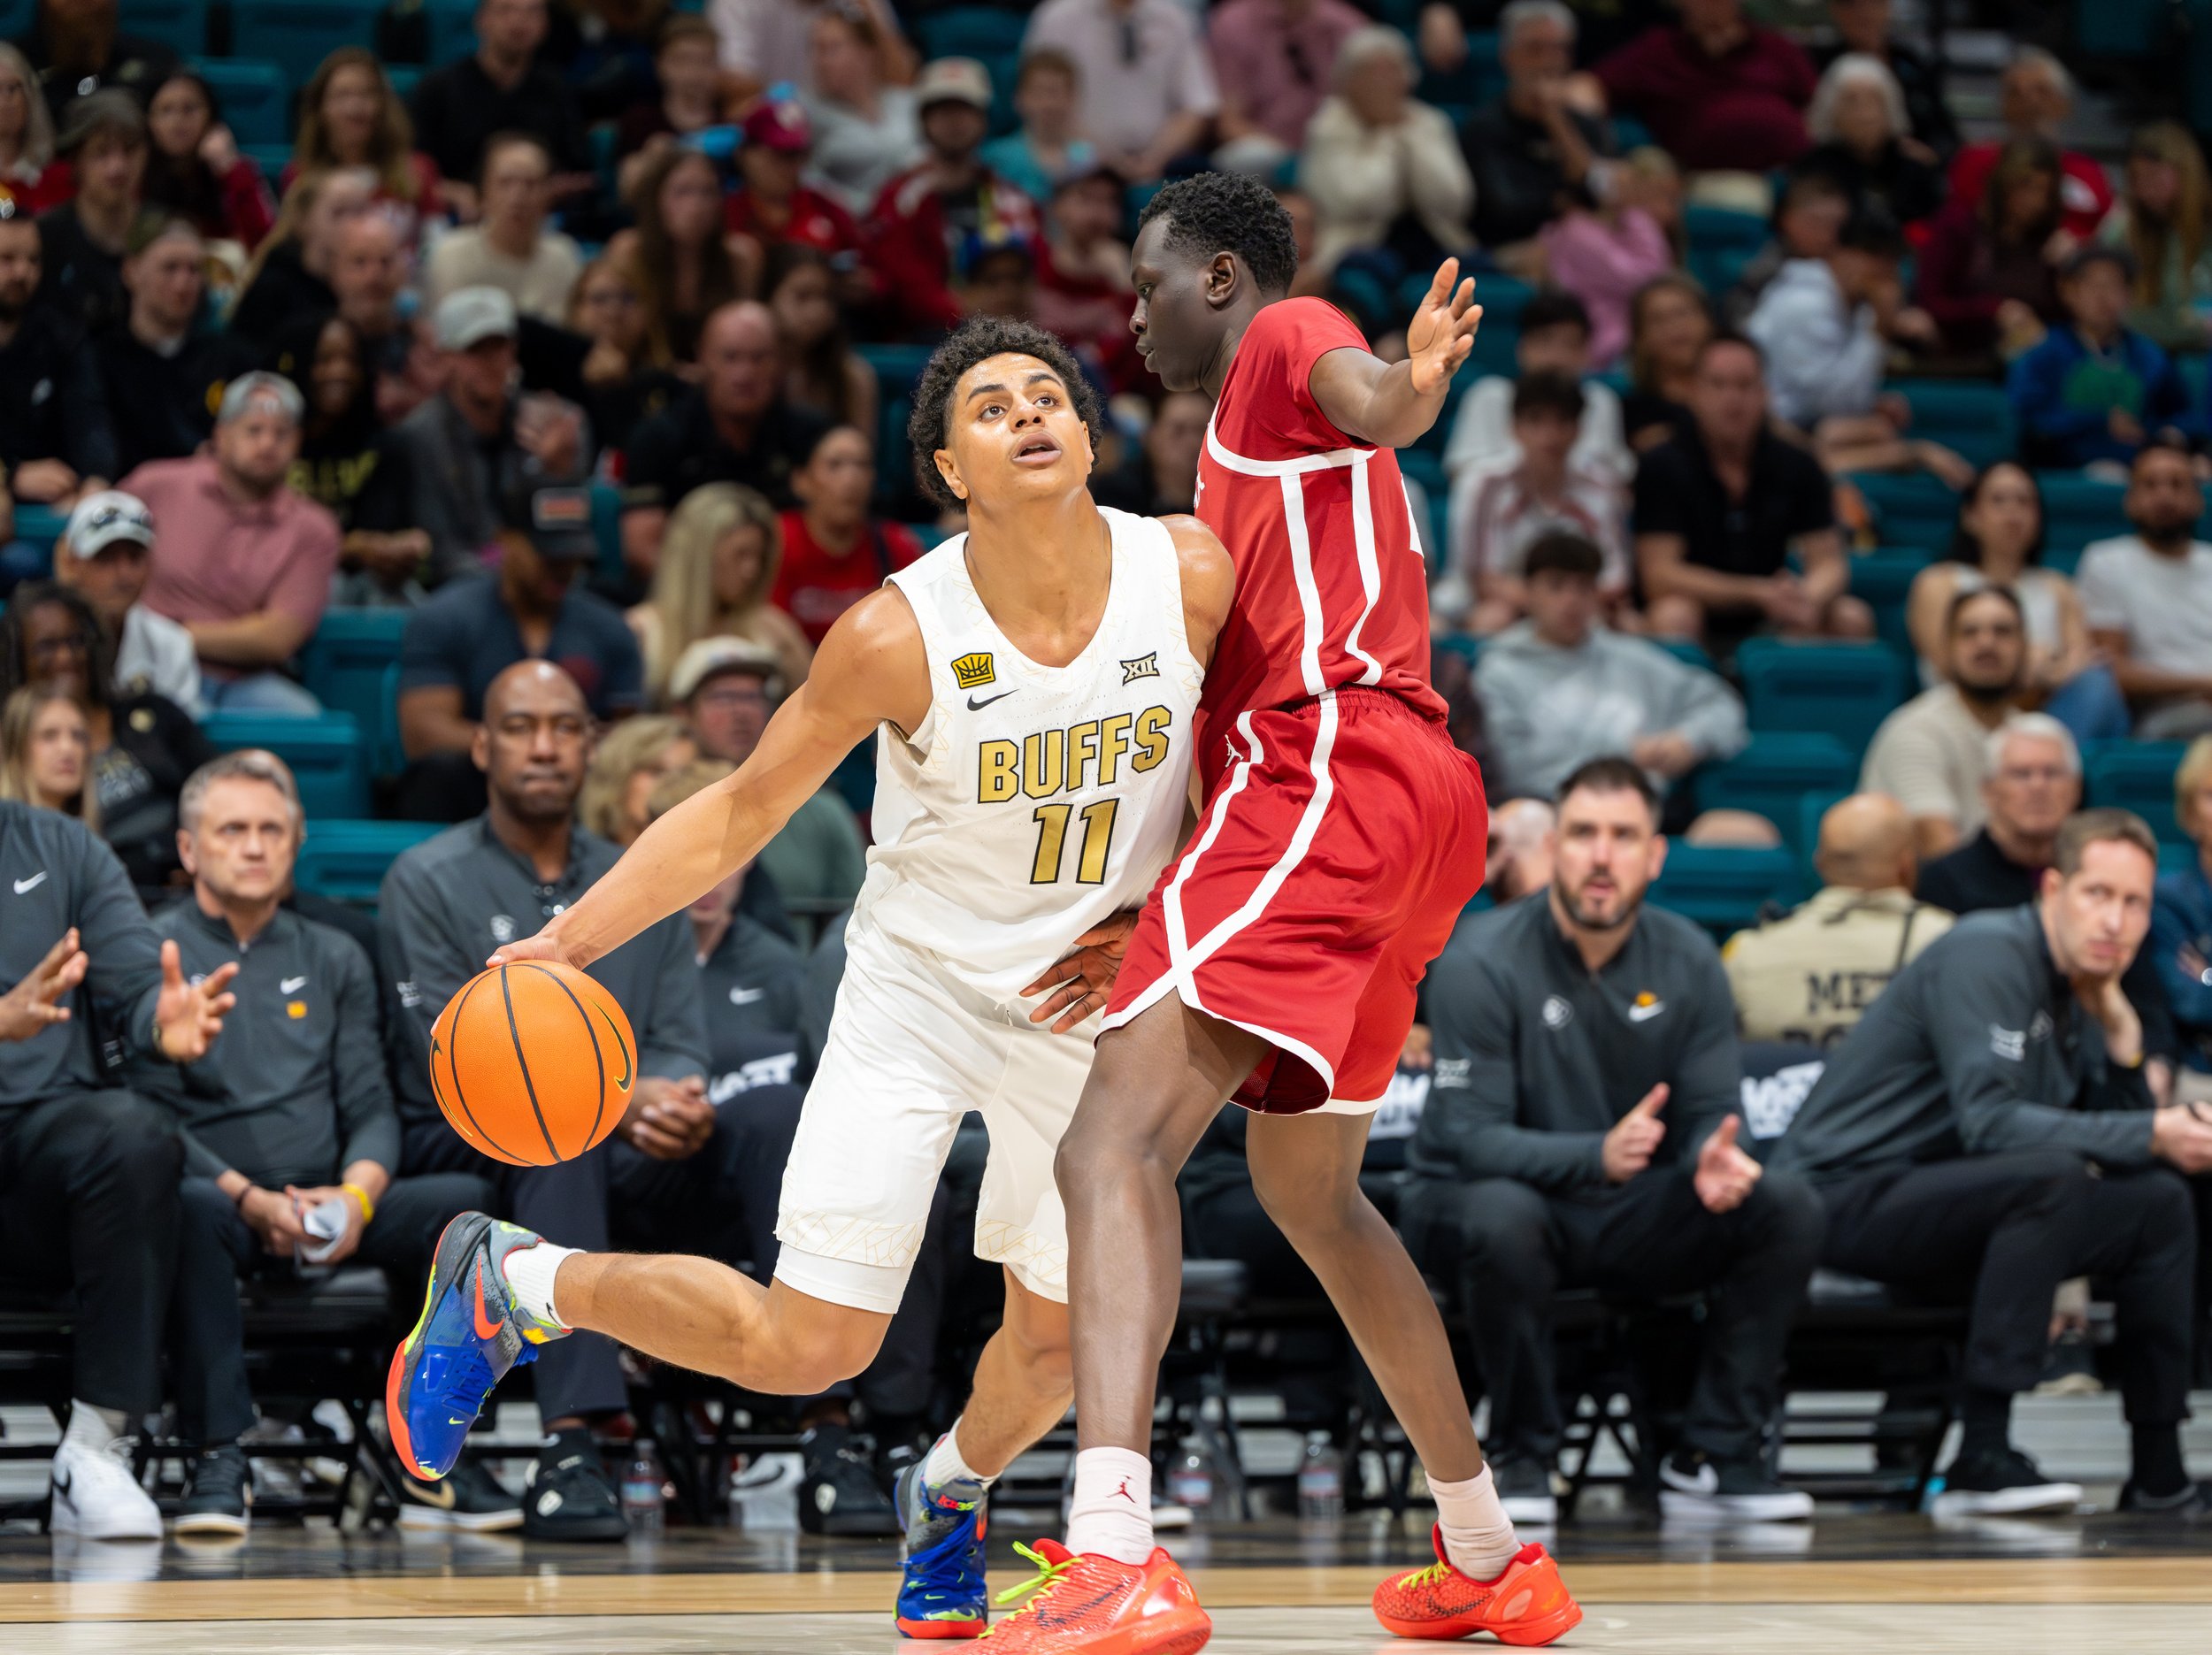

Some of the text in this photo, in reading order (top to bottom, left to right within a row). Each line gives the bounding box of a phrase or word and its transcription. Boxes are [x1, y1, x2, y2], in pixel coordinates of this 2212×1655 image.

[1119, 651, 1160, 686] XII
[978, 705, 1172, 804] BUFFS
[1029, 798, 1121, 885] 11
